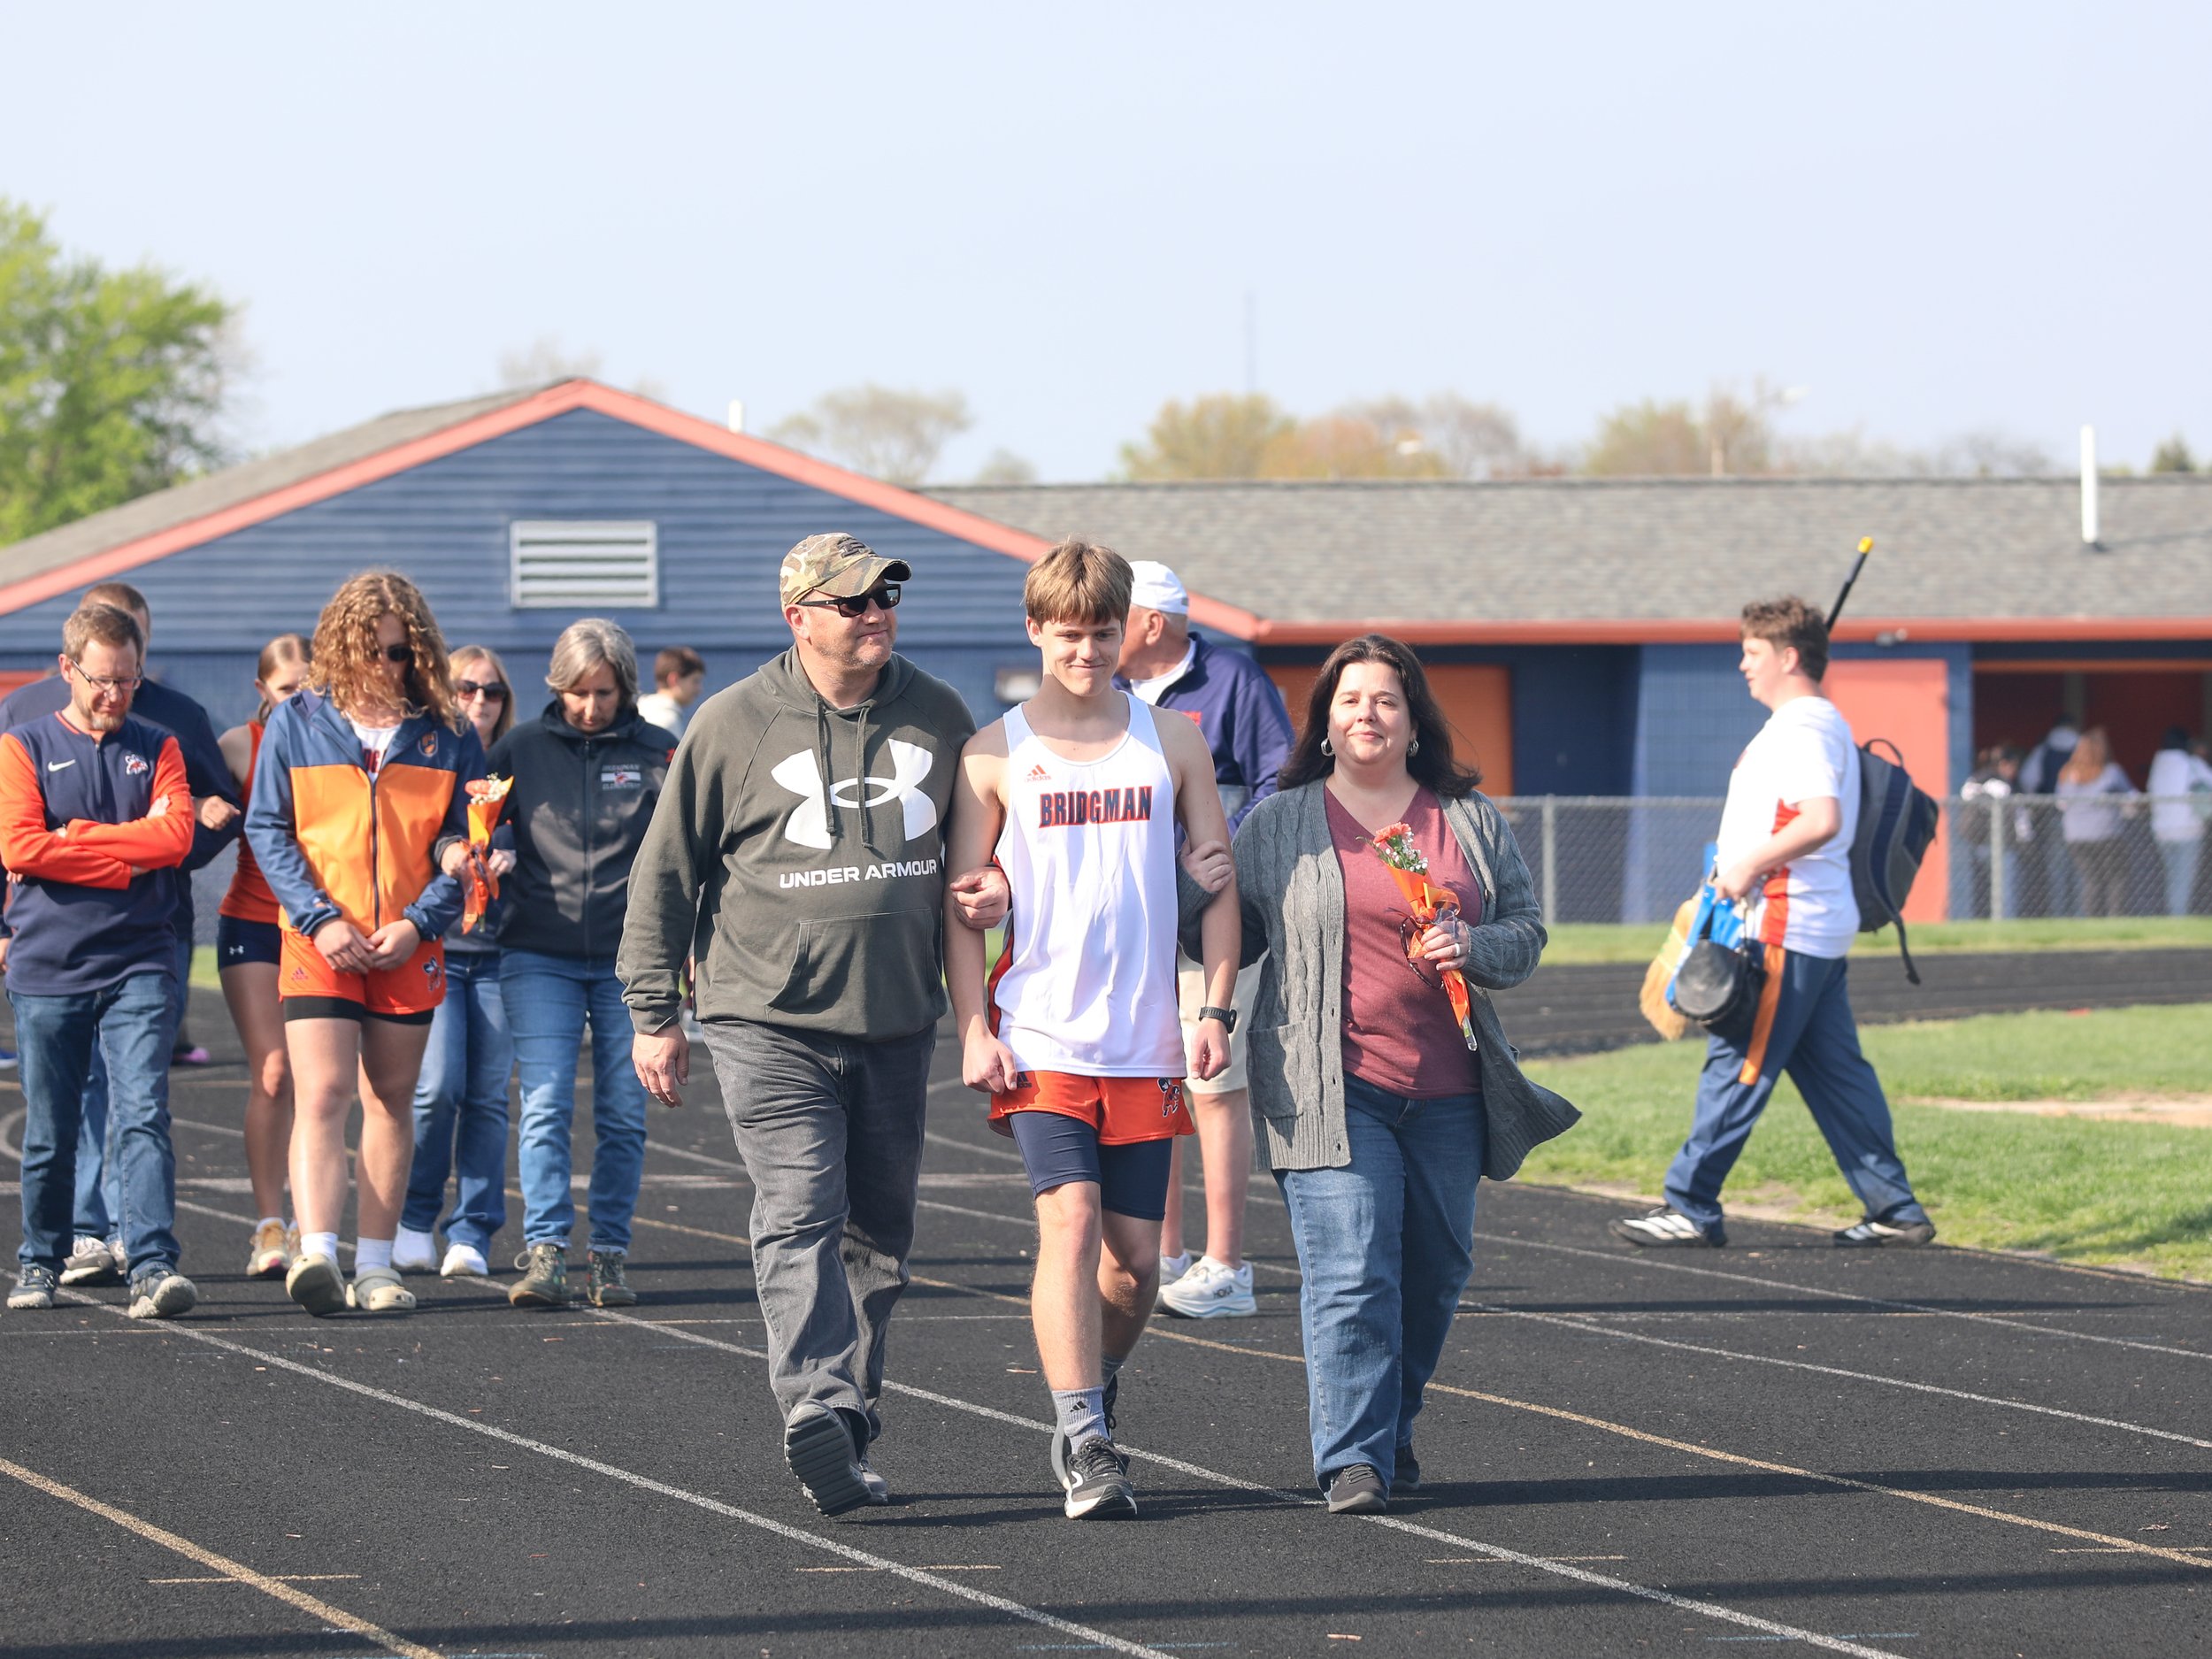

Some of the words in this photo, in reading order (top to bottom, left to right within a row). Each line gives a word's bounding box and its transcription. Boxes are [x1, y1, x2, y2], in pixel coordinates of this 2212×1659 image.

[1039, 786, 1152, 827] BRIDGMAN
[780, 866, 860, 888] UNDER
[864, 859, 937, 879] ARMOUR
